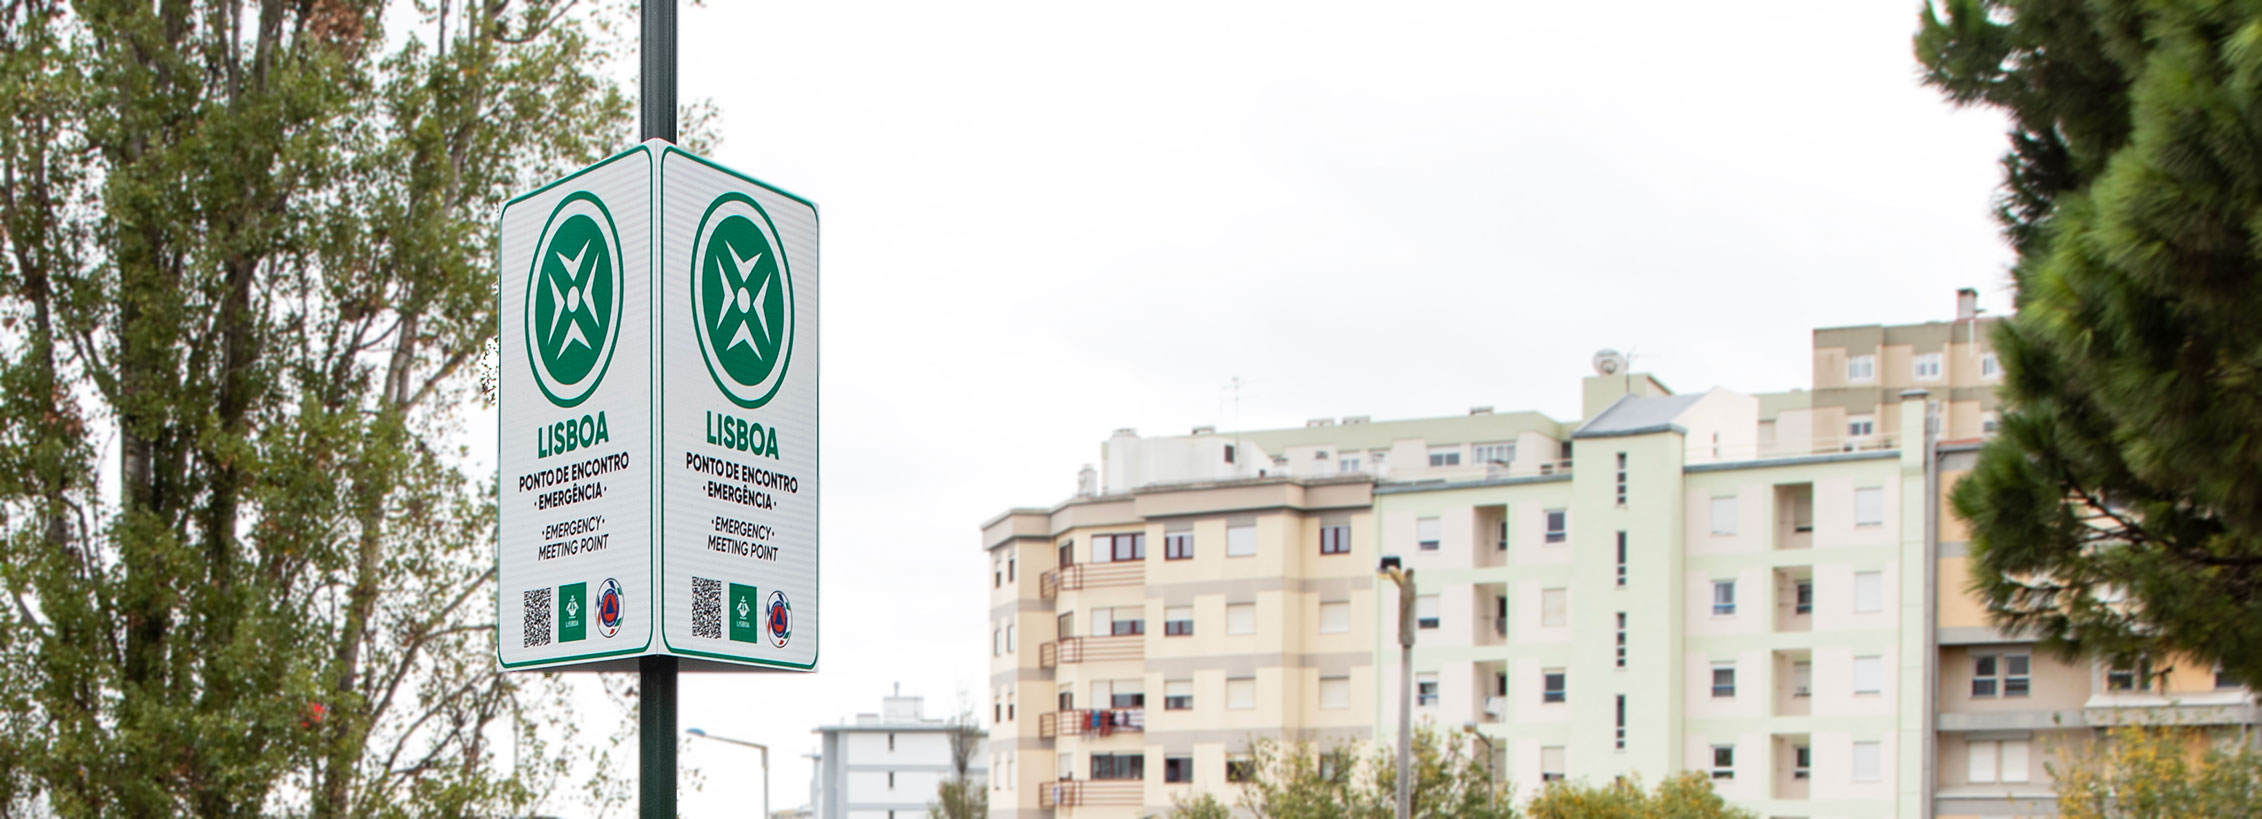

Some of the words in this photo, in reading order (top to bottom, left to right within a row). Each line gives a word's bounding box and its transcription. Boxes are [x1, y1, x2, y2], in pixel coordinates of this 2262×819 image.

[538, 410, 609, 459] LISBOA
[706, 410, 780, 460] LISBOA
[519, 469, 555, 493] PONTO
[556, 466, 569, 485] DE
[571, 451, 629, 482] ENCONTRO
[686, 451, 724, 477] PONTO
[726, 461, 739, 481] DE
[742, 464, 798, 494] ENCONTRO
[538, 540, 578, 561] MEETING
[580, 534, 609, 554] POINT
[707, 534, 748, 557] MEETING
[750, 543, 779, 562] POINT
